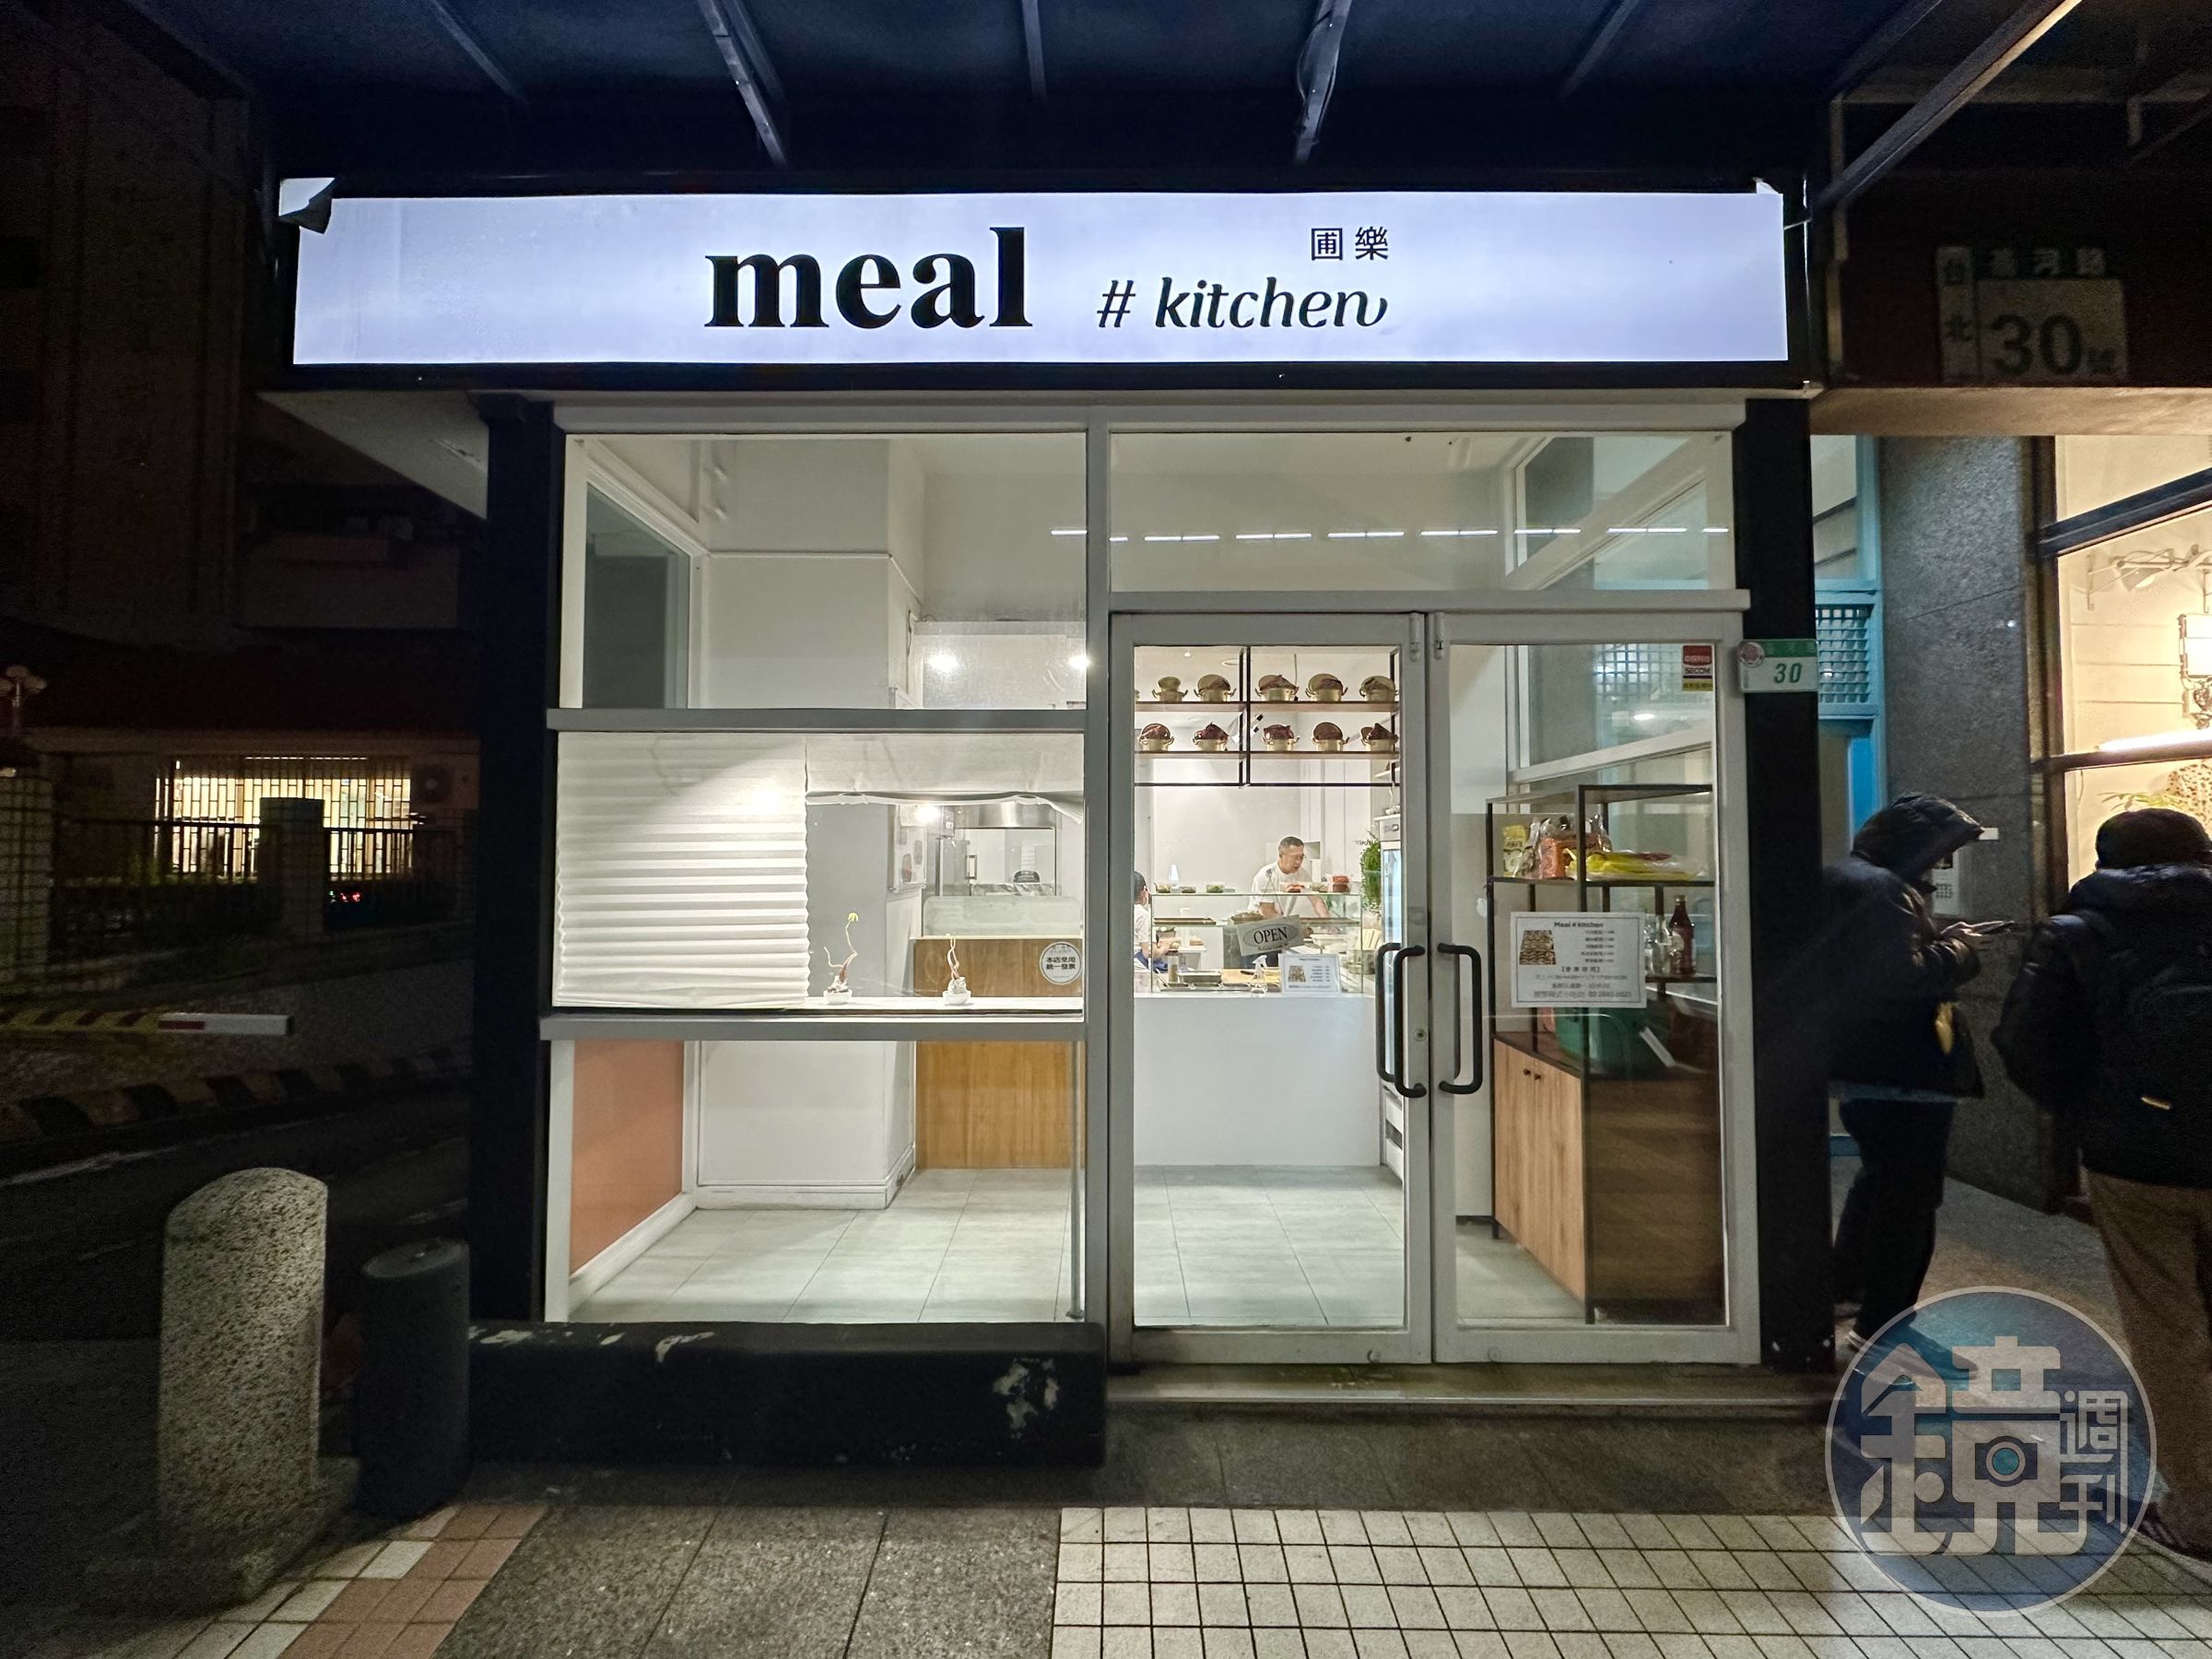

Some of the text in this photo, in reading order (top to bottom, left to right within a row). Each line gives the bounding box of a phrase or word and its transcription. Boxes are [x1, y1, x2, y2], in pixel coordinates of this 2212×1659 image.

[1311, 227, 1389, 261] 圃樂
[704, 227, 1388, 329] meal # kitchen
[1773, 662, 1804, 685] 30
[1253, 926, 1288, 945] OPEN
